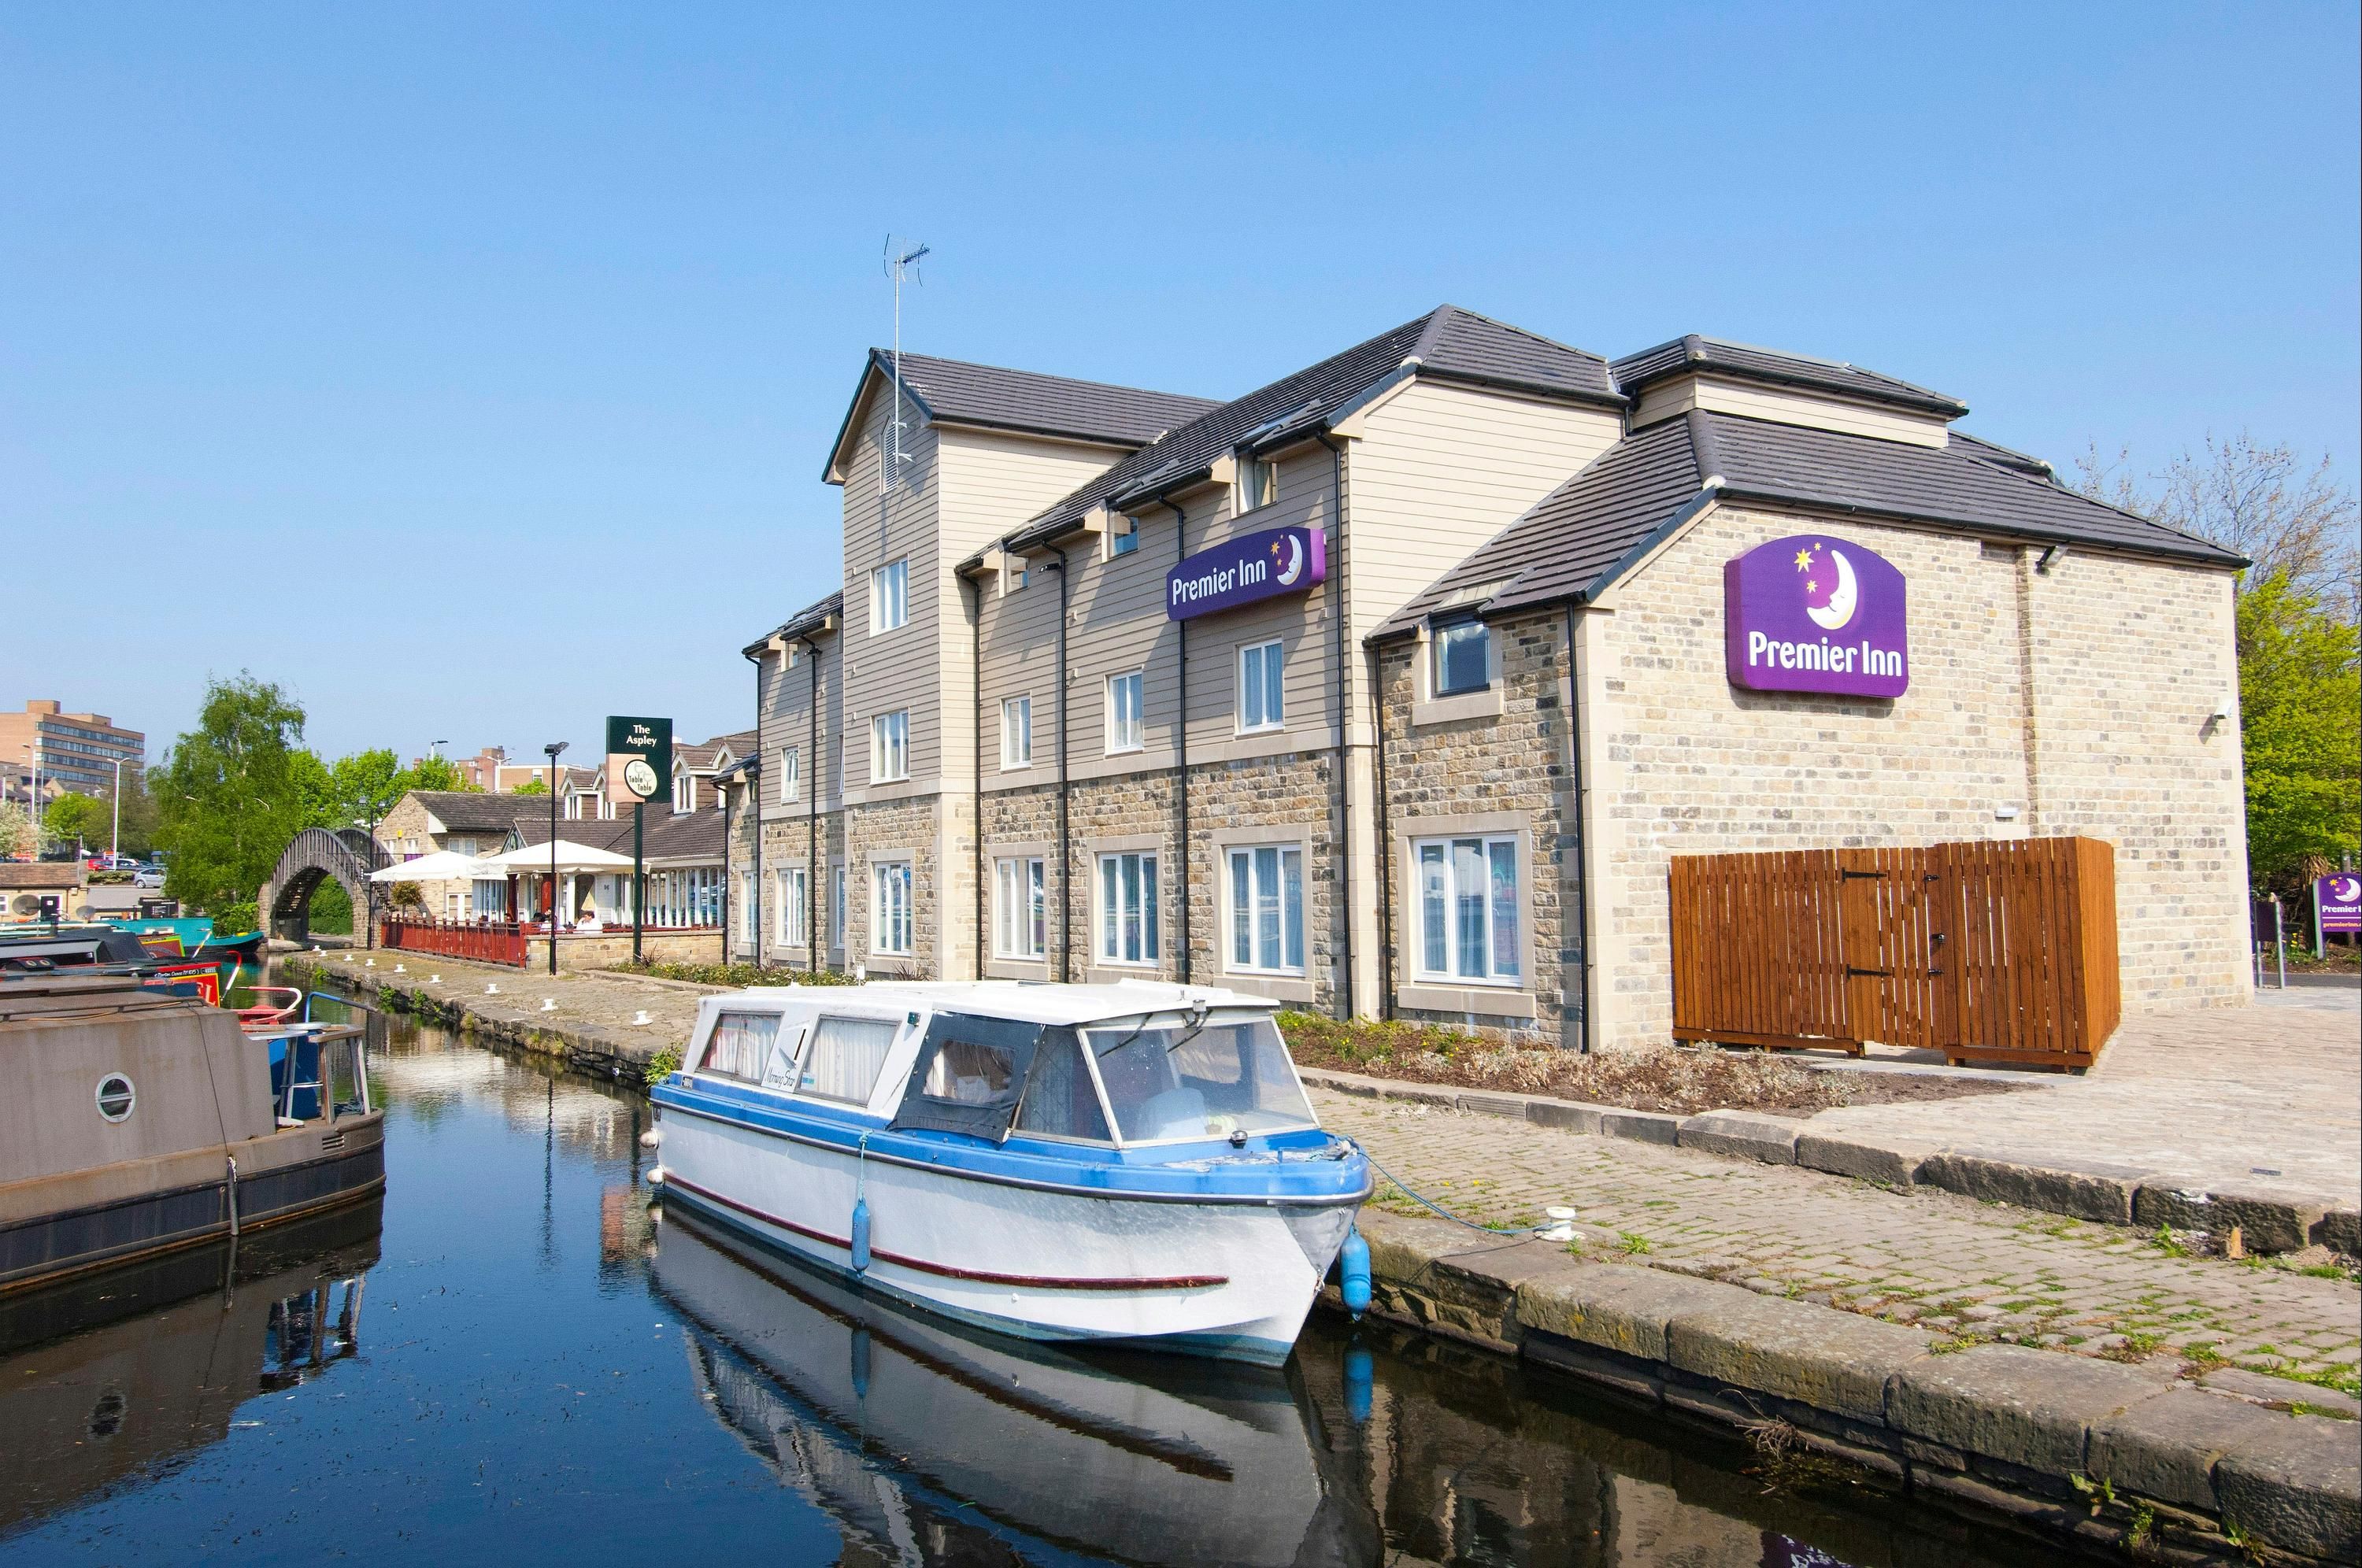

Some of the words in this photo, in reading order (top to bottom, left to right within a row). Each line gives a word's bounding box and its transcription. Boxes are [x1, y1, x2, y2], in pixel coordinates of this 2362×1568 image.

[1172, 567, 1235, 605] Premier
[1239, 559, 1266, 586] Inn
[1749, 631, 1858, 673] Premier
[1862, 641, 1902, 677] Inn
[633, 724, 650, 734] The
[626, 735, 657, 747] Aspley
[638, 782, 652, 791] Table
